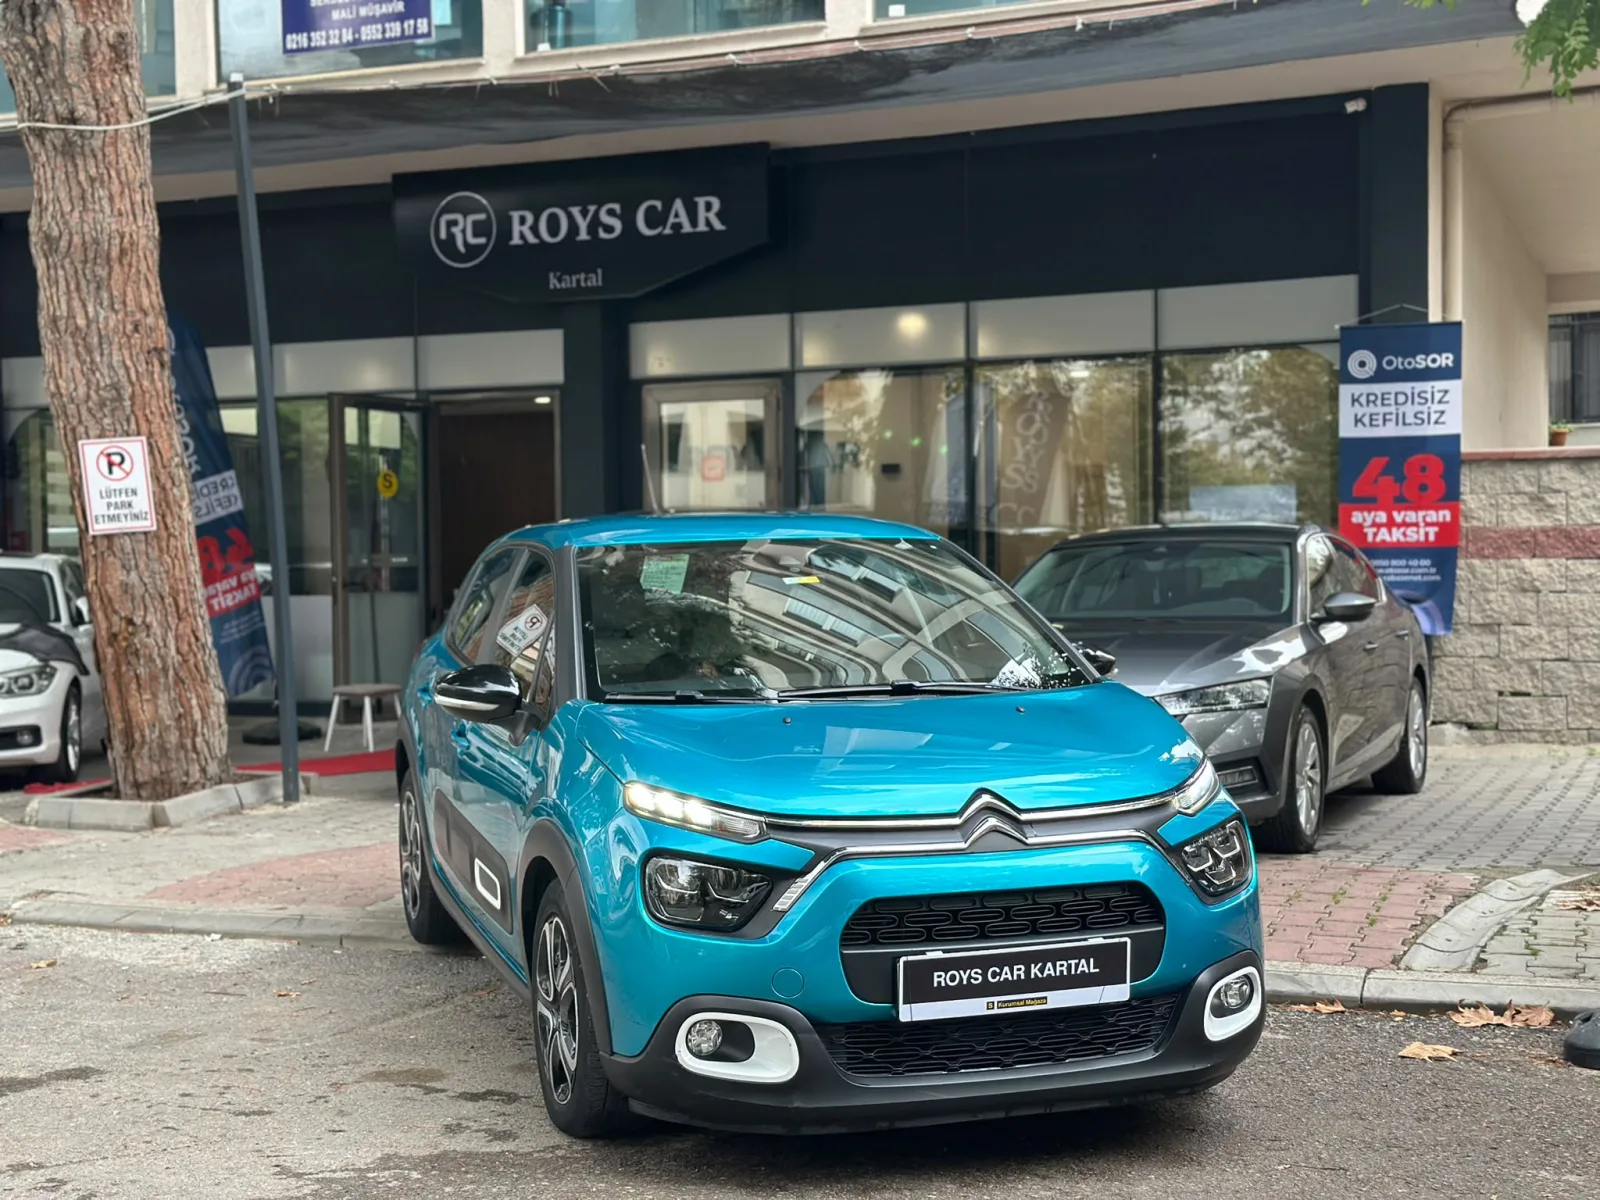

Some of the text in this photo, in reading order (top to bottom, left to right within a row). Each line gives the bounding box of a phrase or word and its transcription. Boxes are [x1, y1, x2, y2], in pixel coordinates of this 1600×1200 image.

[331, 7, 357, 21] MALİ
[359, 1, 405, 17] MÜŞAVİR
[286, 32, 309, 49] 0216
[310, 30, 327, 47] 352
[329, 29, 340, 45] 32
[361, 24, 383, 41] 0552
[404, 19, 415, 36] 17
[508, 196, 727, 246] ROYS CAR
[549, 268, 603, 290] Kartal
[1382, 352, 1455, 371] OtoSOR
[1350, 386, 1450, 408] KREDİSİZ
[1353, 406, 1447, 429] KEFİLSİZ
[383, 473, 393, 489] S
[1352, 453, 1447, 506] 48
[99, 486, 138, 499] LÜTFEN
[106, 500, 134, 511] PARK
[94, 510, 149, 525] ETMEYİNİZ
[1351, 509, 1451, 526] aya varan
[1363, 523, 1439, 543] TAKSİT
[933, 957, 1100, 988] ROYS CAR KARTAL
[998, 1000, 1025, 1008] Kurumsal
[1026, 998, 1047, 1006] Mağaza
